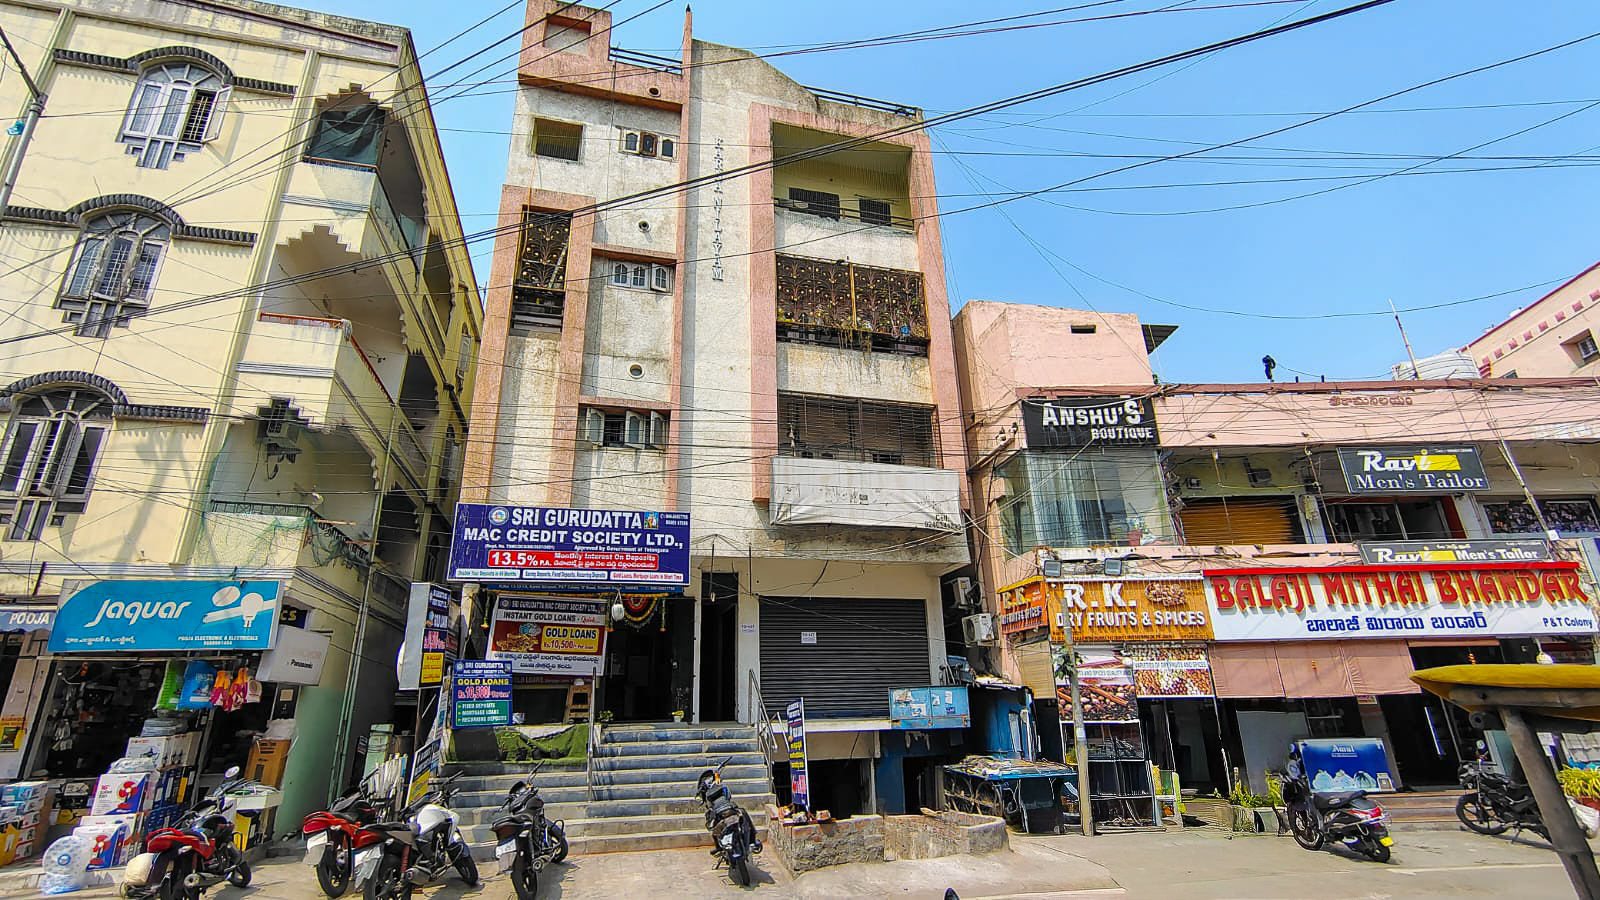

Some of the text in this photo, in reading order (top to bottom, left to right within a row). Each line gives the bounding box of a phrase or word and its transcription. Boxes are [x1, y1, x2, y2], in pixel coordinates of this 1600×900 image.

[1042, 399, 1142, 426] ANSHU'S
[1091, 427, 1154, 440] BOUTIQUE
[1357, 449, 1431, 471] Ravi
[1354, 473, 1483, 489] Men's Tailor
[512, 508, 540, 526] SRI
[545, 509, 642, 529] GURUDATTA
[463, 527, 684, 549] MAC CREDIT SOCIETY LTD.,
[491, 552, 538, 566] 13.5%
[554, 552, 582, 561] Monthly
[626, 554, 656, 562] Deposits
[1372, 546, 1538, 562] Ravi Men's Tailor
[1211, 571, 1589, 612] BALAJI MITHAI BHANDAR
[9, 611, 49, 624] POOJA
[83, 598, 192, 627] Jaquar
[504, 611, 531, 620] INSTANT
[554, 614, 576, 622] LOANS
[1056, 611, 1206, 627] DRY FRUITS & SPICES
[1306, 616, 1361, 632] బాలాజీ
[1431, 611, 1488, 629] బండార్
[1564, 617, 1592, 628] Colony
[545, 627, 597, 639] GOLD LOANS
